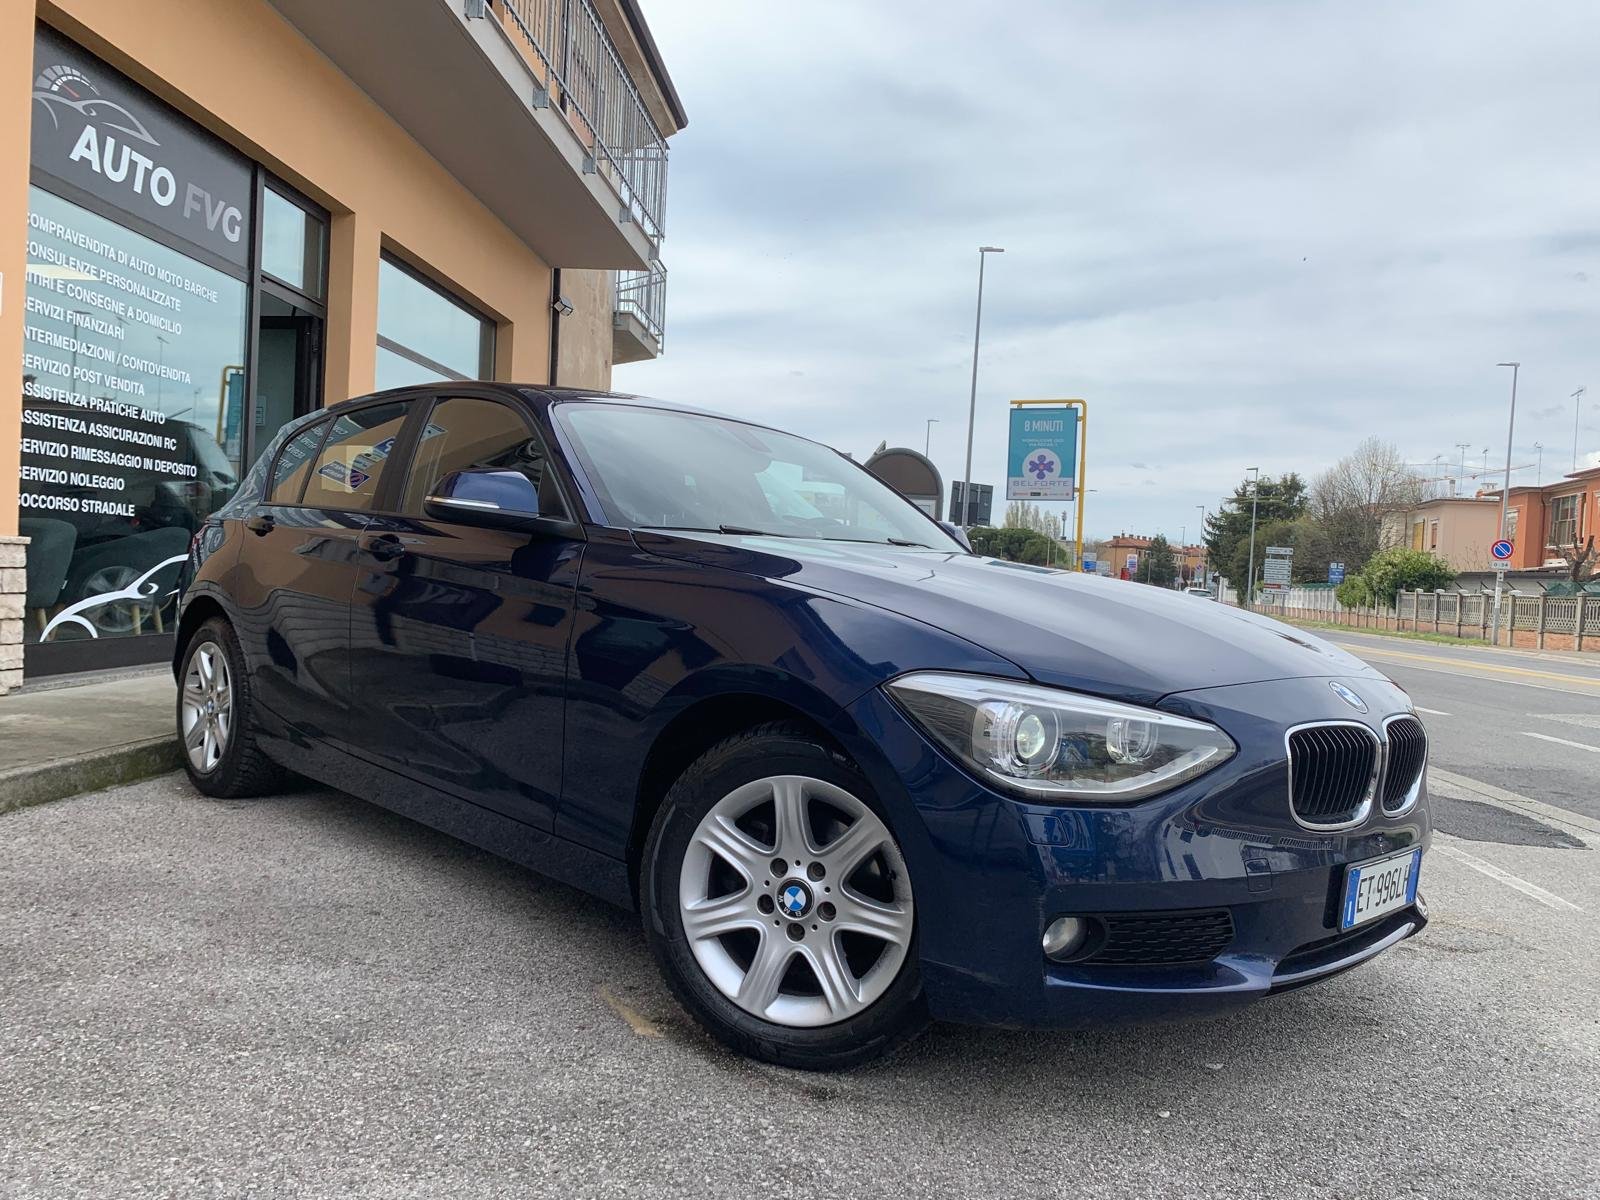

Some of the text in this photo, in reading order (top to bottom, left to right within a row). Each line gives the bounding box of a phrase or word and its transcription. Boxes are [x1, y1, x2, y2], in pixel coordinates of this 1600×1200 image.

[69, 124, 243, 244] AUTO FVG
[26, 241, 182, 312] ONSULENZE PERSONALIZZATE
[118, 250, 128, 265] DI
[129, 256, 156, 276] AUTO
[157, 267, 183, 288] MOTO
[184, 279, 218, 303] BARCHE
[25, 271, 182, 335] ITIRI E CONSEGNE A DOMICILIO
[66, 310, 125, 341] FINANZIARI
[23, 325, 114, 363] NTERMEDIAZIONI
[122, 354, 191, 384] CONTOVENDITA
[73, 366, 102, 385] POST
[104, 374, 145, 396] VENDITA
[89, 396, 139, 419] PRATICHE
[140, 408, 166, 424] AUTO
[88, 422, 162, 448] ASSICURAZIONI
[164, 437, 177, 451] RC
[1032, 420, 1064, 432] MINUTI
[71, 445, 142, 468] RIMESSAGGIO
[143, 457, 153, 471] IN
[154, 459, 197, 477] DEPOSITO
[70, 472, 125, 491] NOLEGGIO
[81, 499, 135, 517] STRADALE
[1357, 875, 1376, 913] ET
